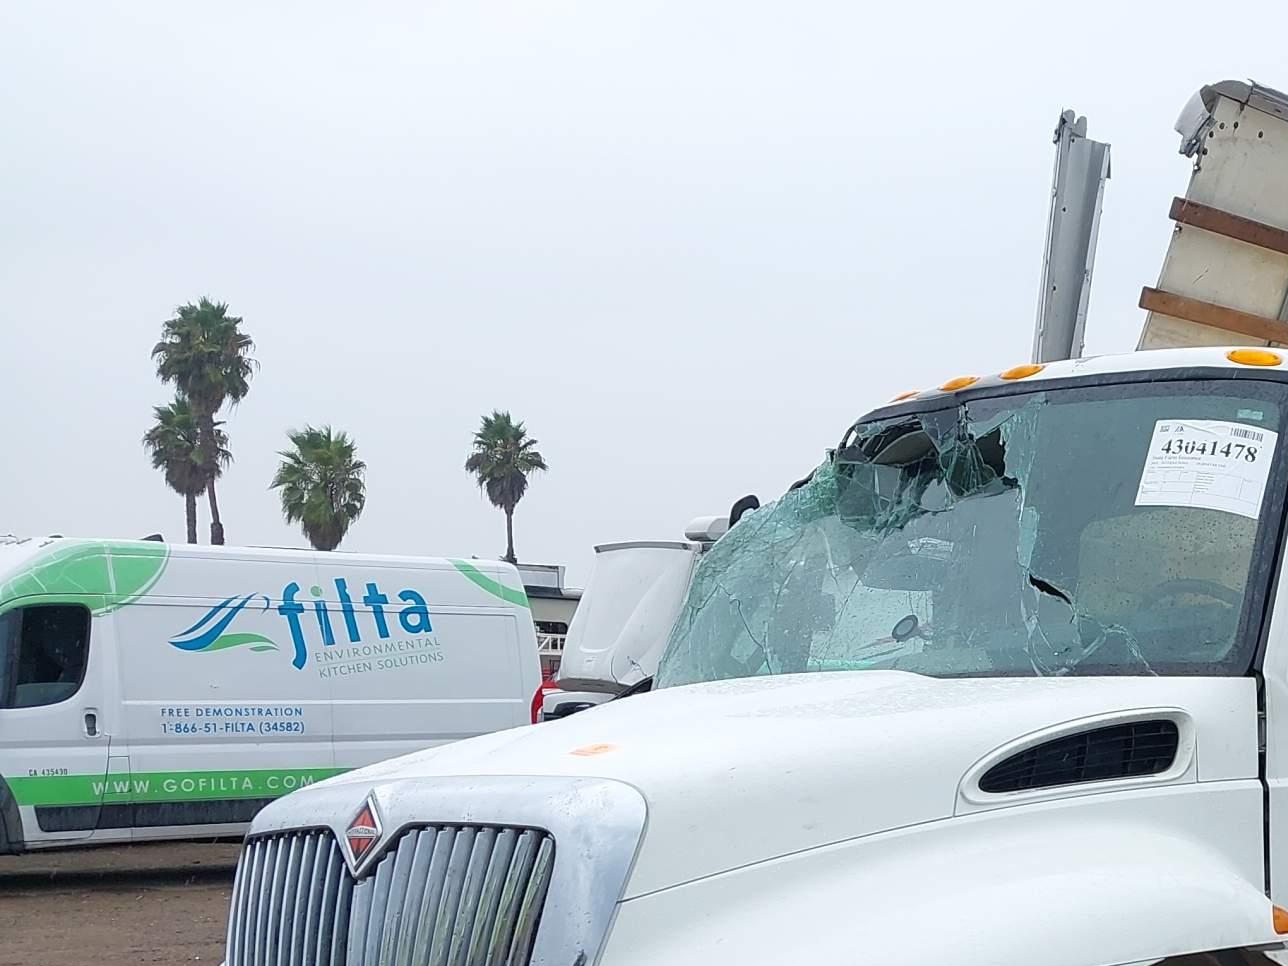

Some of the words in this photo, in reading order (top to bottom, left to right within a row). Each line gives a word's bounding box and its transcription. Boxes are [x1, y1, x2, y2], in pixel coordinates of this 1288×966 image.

[1161, 438, 1258, 463] 43041478
[278, 577, 433, 670] filta
[315, 637, 441, 663] ENVIRONMENTAL
[319, 664, 373, 679] KITCHEN
[377, 651, 444, 670] SOLUTIONS
[161, 708, 190, 718] FREE
[195, 707, 303, 718] DEMONSTRATION
[161, 721, 256, 733] 1-866-51-FILTA
[259, 721, 305, 733] (34582)
[92, 775, 314, 796] WWW.GOFILTA.COM
